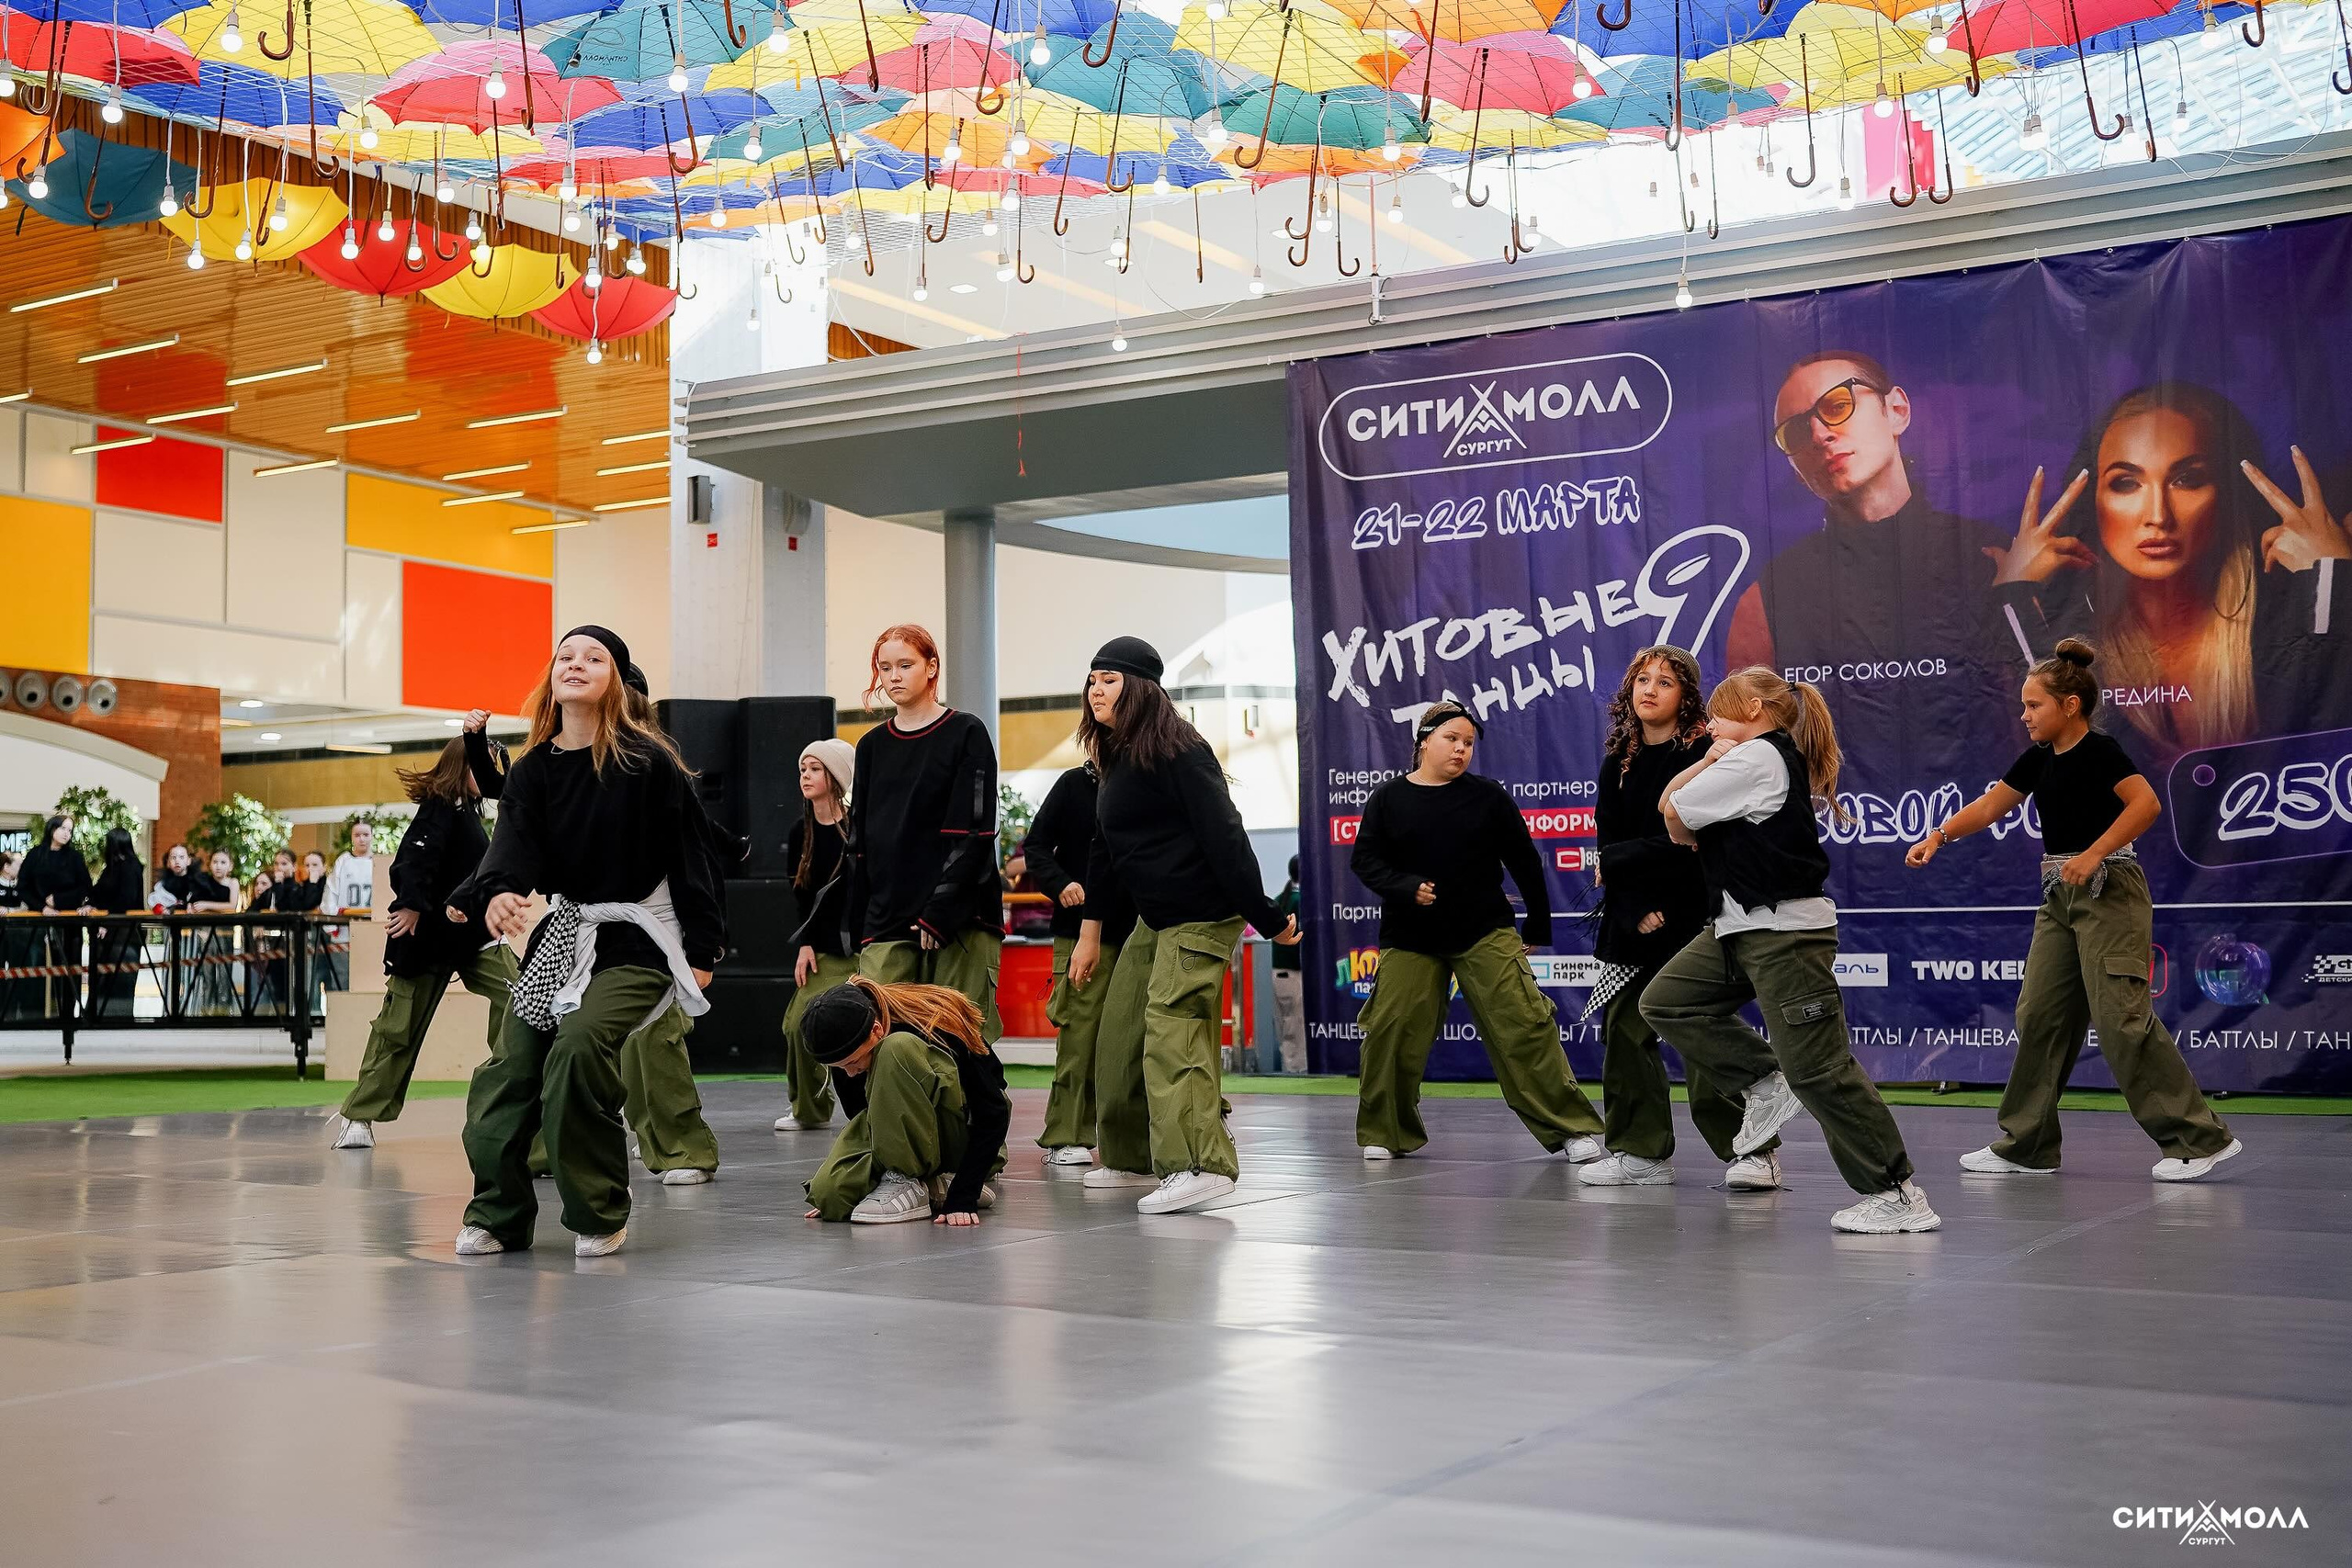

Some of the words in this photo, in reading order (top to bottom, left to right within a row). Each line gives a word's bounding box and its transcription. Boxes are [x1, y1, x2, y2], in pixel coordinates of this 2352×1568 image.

[1456, 438, 1513, 457] СУРГУТ
[1351, 496, 1488, 550] 21-22
[1496, 475, 1641, 536] МАРТА
[1785, 665, 1833, 683] ЕГОР
[1838, 658, 1948, 682] СОКОЛОВ
[2101, 684, 2193, 707] РЕДИНА
[1329, 768, 1410, 787] Генера
[1512, 780, 1598, 800] партнер
[1553, 962, 1601, 971] синема
[1912, 960, 1974, 981] TWO
[1553, 971, 1586, 983] парк
[1443, 1023, 1482, 1041] ШО
[2190, 1030, 2278, 1049] БАТТЛЫ
